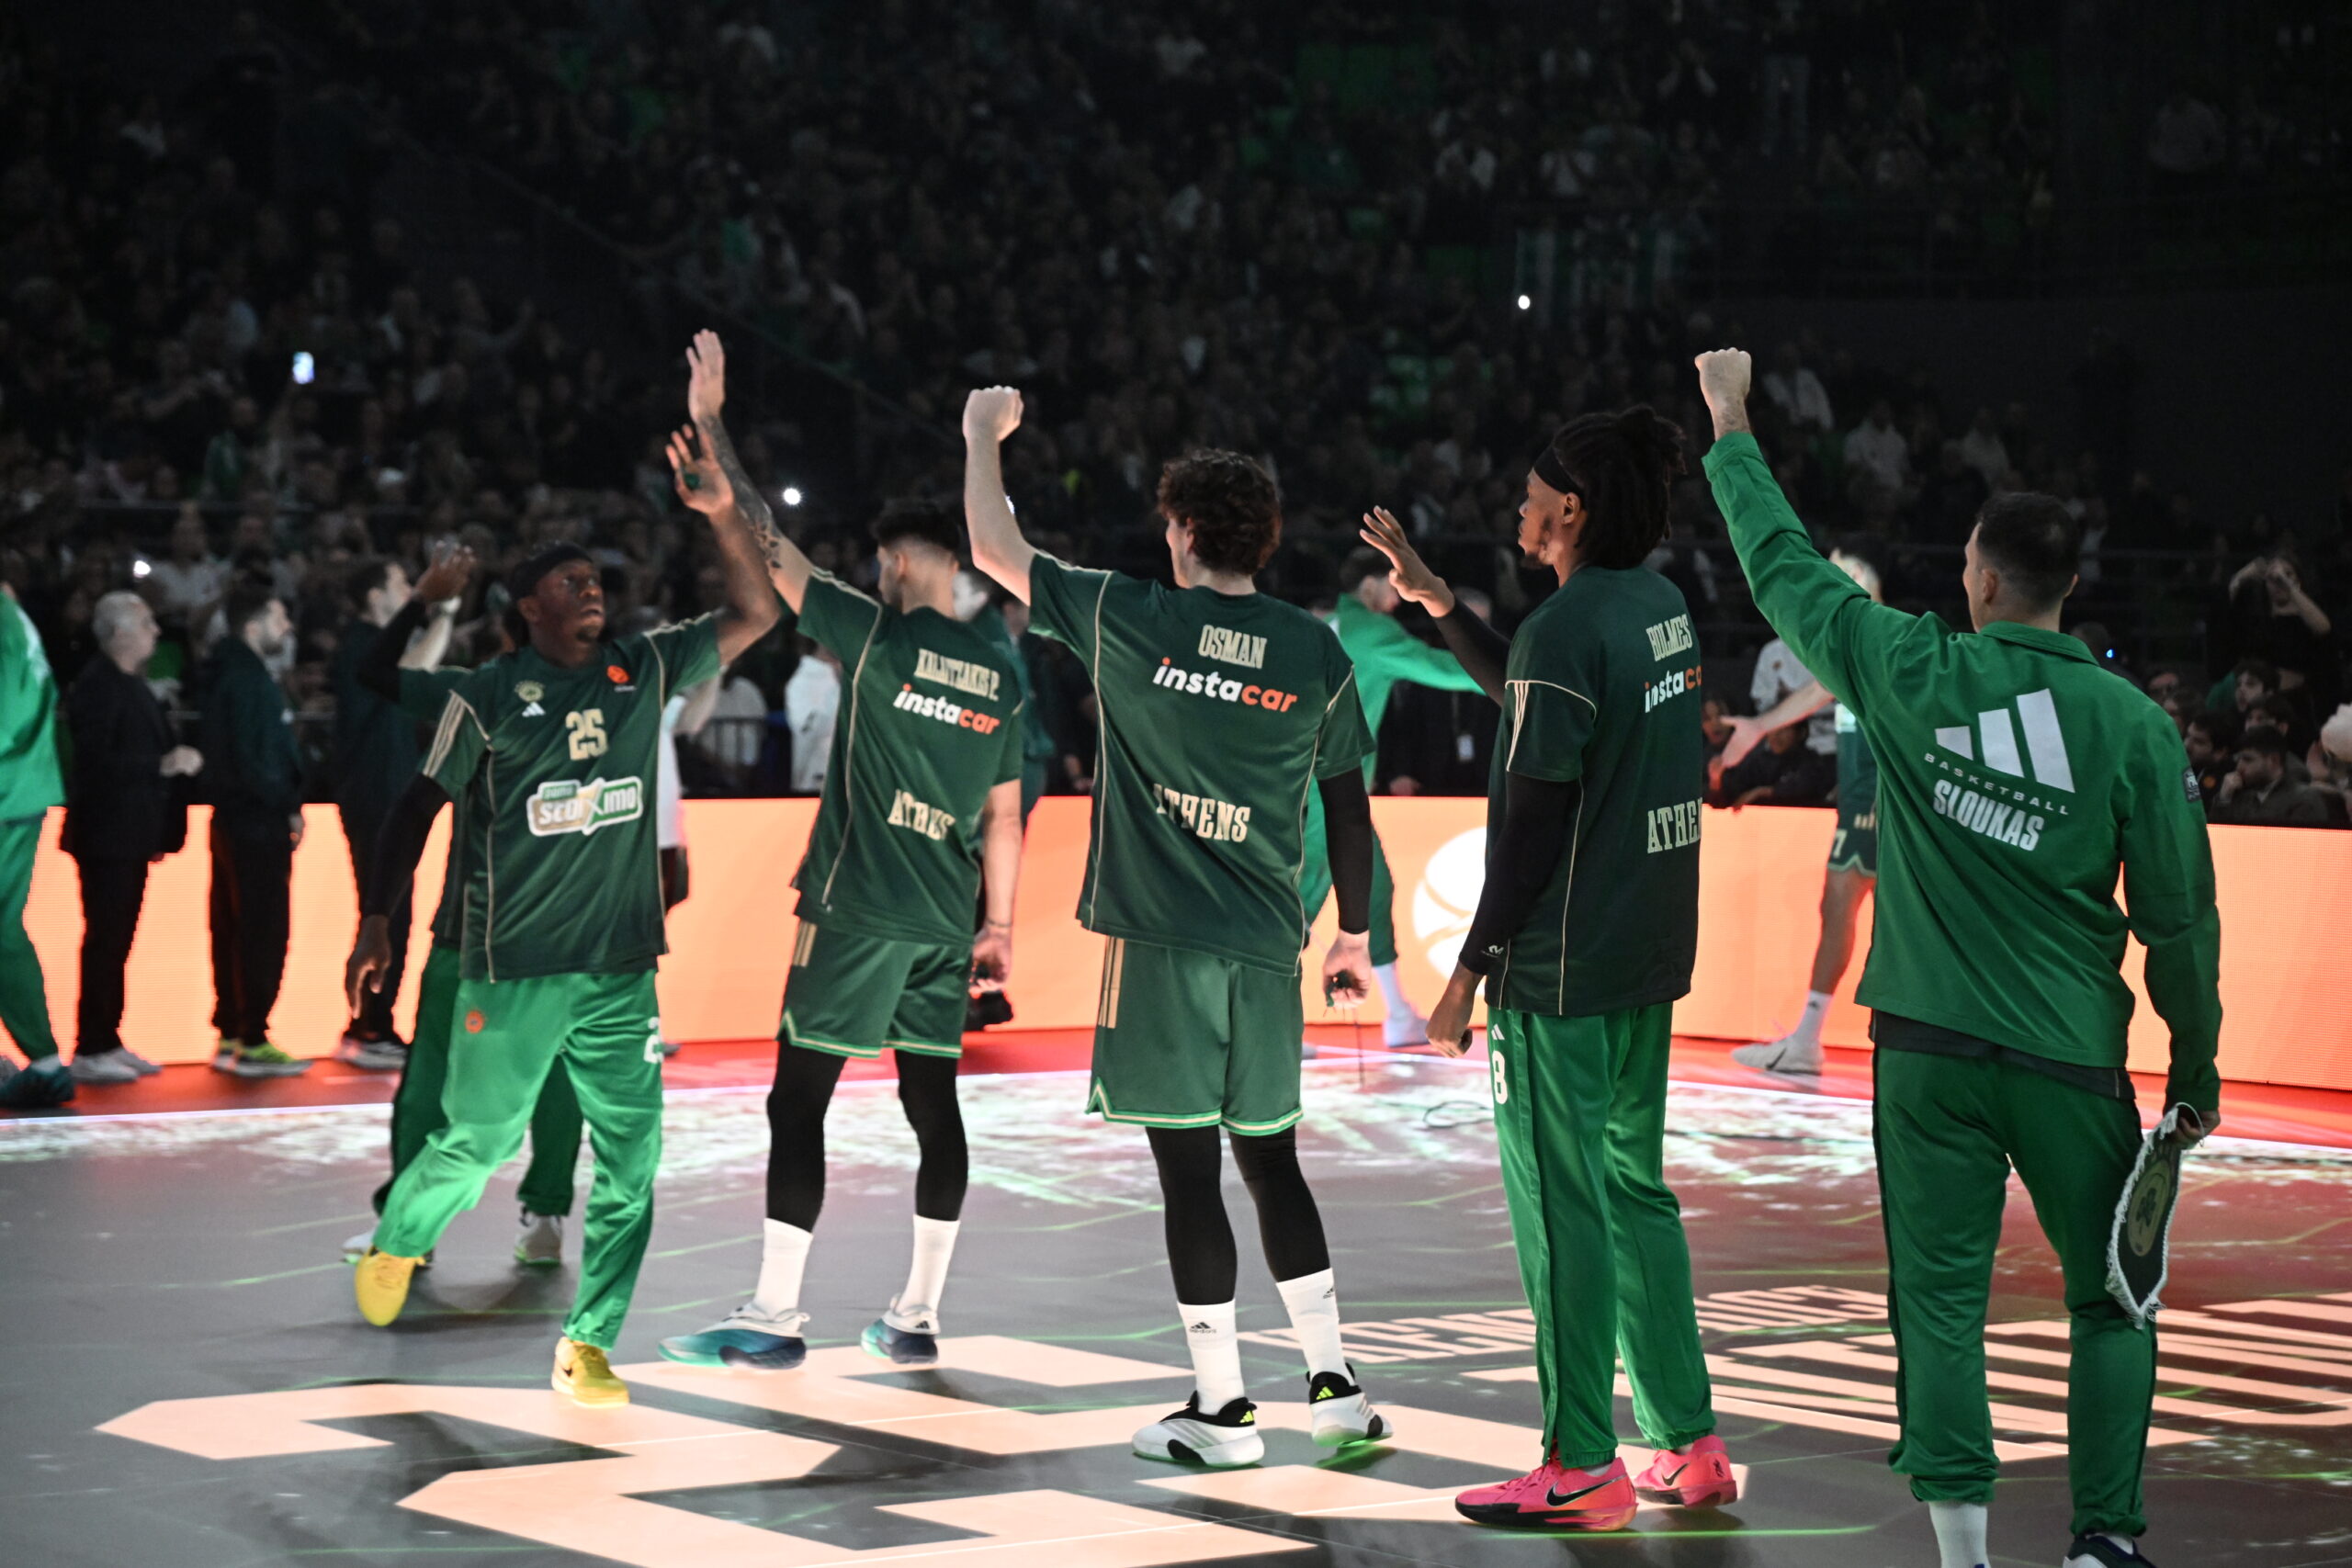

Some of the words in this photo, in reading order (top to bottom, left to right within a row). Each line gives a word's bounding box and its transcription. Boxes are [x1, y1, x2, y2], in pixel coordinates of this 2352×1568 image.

[1198, 624, 1268, 670] OSMAN
[1645, 614, 1692, 661] HOLMES
[892, 682, 1001, 735] instacar
[1152, 657, 1299, 713] instacar
[565, 708, 608, 761] 25
[1924, 752, 2070, 816] BASKETBALL
[1932, 779, 2045, 852] SLOUKAS
